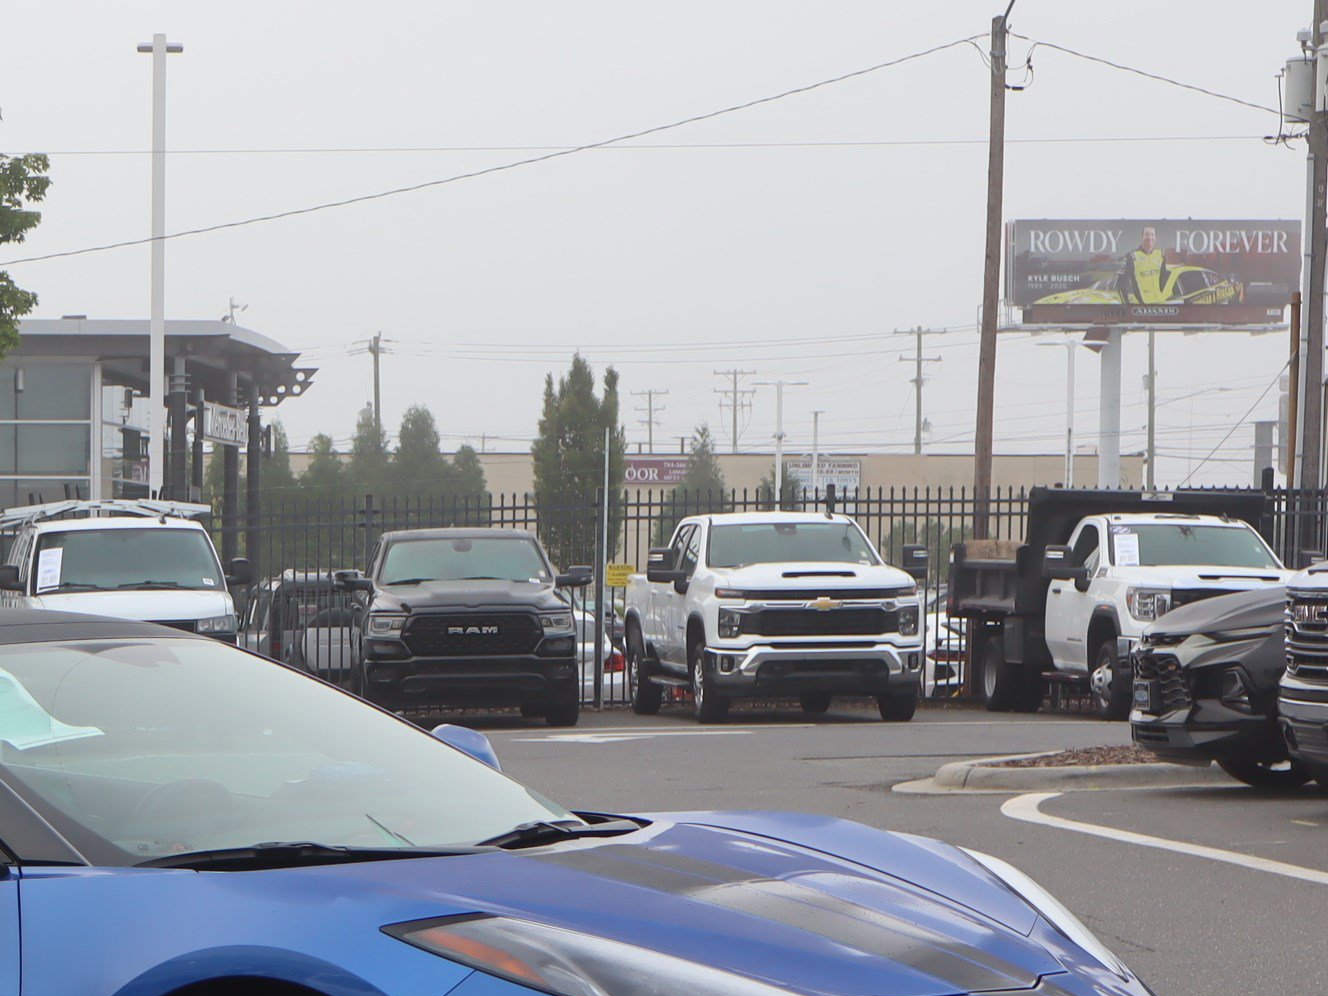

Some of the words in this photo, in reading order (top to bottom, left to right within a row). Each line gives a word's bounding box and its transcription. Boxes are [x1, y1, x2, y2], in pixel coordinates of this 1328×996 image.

[1029, 230, 1122, 253] ROWDY
[1175, 230, 1288, 253] FOREVER
[448, 626, 498, 634] RAM
